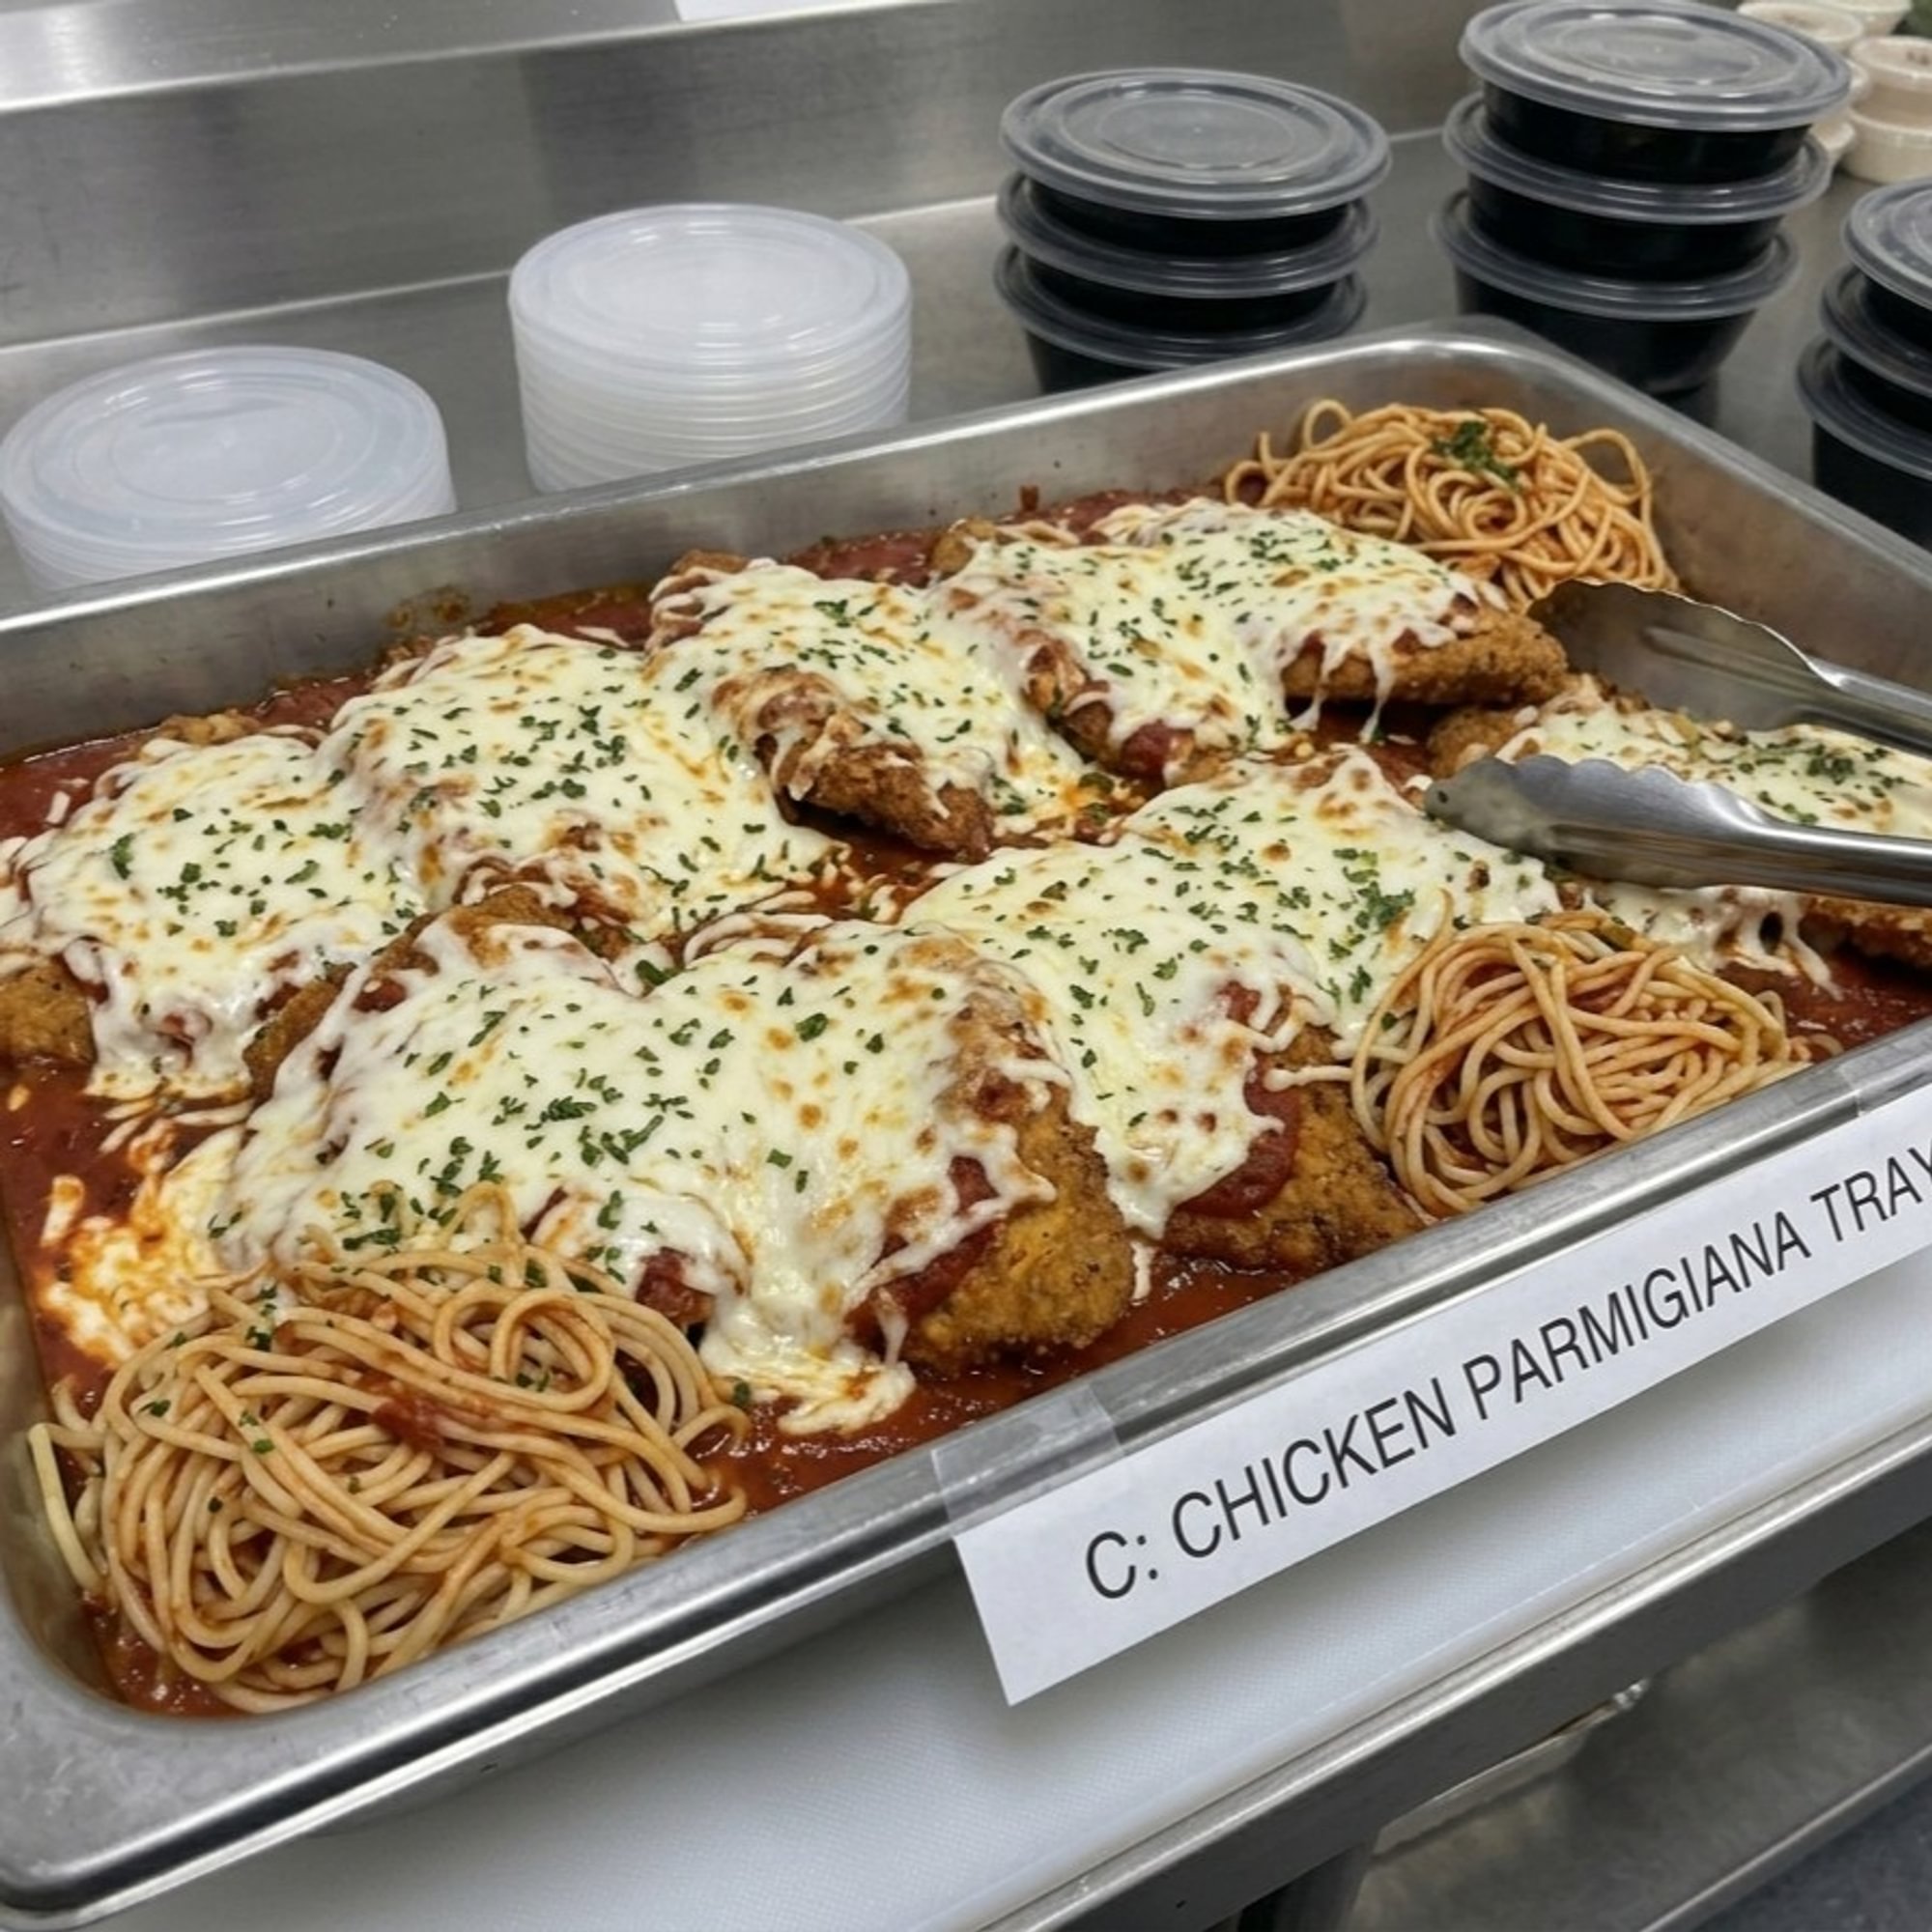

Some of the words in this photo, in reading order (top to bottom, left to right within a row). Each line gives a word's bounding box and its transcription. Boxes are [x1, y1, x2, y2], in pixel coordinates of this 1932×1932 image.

[1086, 1531, 1158, 1600] C:
[1172, 1378, 1456, 1558] CHICKEN
[1463, 1211, 1811, 1420] PARMIGIANA
